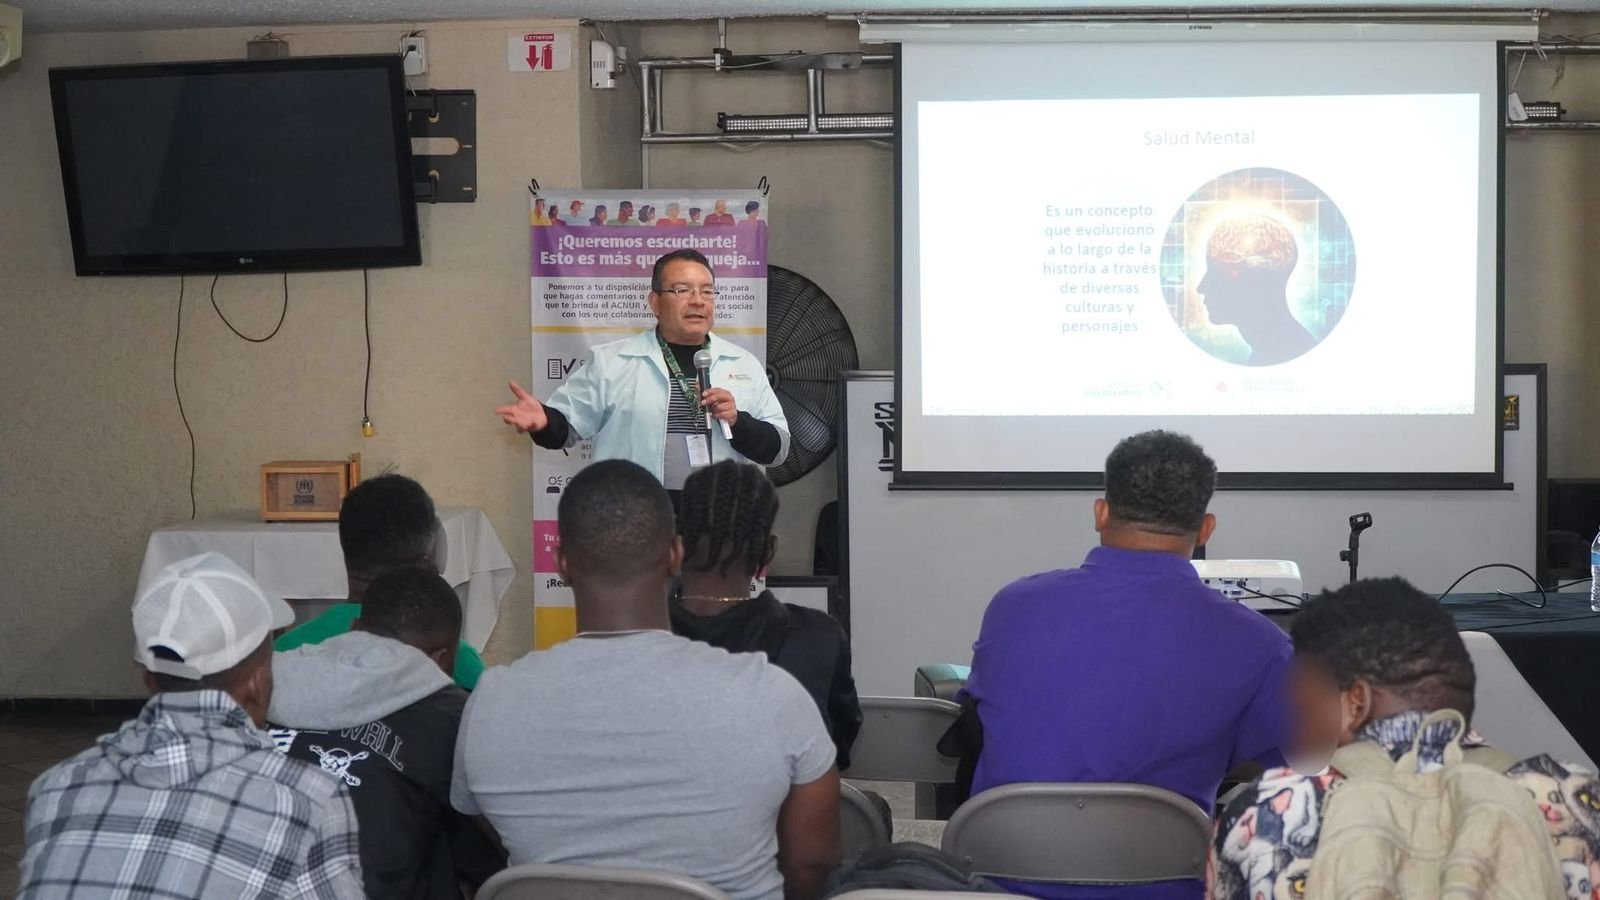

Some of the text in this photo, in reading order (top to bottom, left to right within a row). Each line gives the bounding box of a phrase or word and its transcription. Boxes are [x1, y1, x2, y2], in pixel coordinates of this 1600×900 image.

[1144, 129, 1255, 146] Salud Mental
[1046, 204, 1153, 219] Es un concepto
[1044, 223, 1155, 240] que evolucionó
[558, 234, 737, 250] ¡Queremos escucharte!
[1047, 242, 1152, 258] a lo largo de la
[540, 252, 574, 265] Esto
[578, 254, 595, 265] es
[599, 251, 633, 265] más
[635, 254, 664, 269] qu
[1043, 262, 1157, 275] historia a través
[548, 283, 585, 291] Ponemos
[731, 285, 749, 293] para
[1060, 281, 1140, 294] de diversas
[543, 293, 558, 302] que
[560, 292, 584, 302] hagas
[719, 293, 755, 301] atención
[545, 302, 560, 311] que
[572, 301, 599, 309] brinda
[601, 301, 609, 309] el
[643, 303, 648, 311] y
[728, 302, 753, 310] socias
[1065, 300, 1135, 317] culturas y
[561, 311, 576, 319] con
[578, 311, 591, 319] los
[593, 312, 609, 320] que
[611, 311, 657, 319] colaboram
[1062, 320, 1139, 335] personajes
[544, 534, 554, 542] Tu
